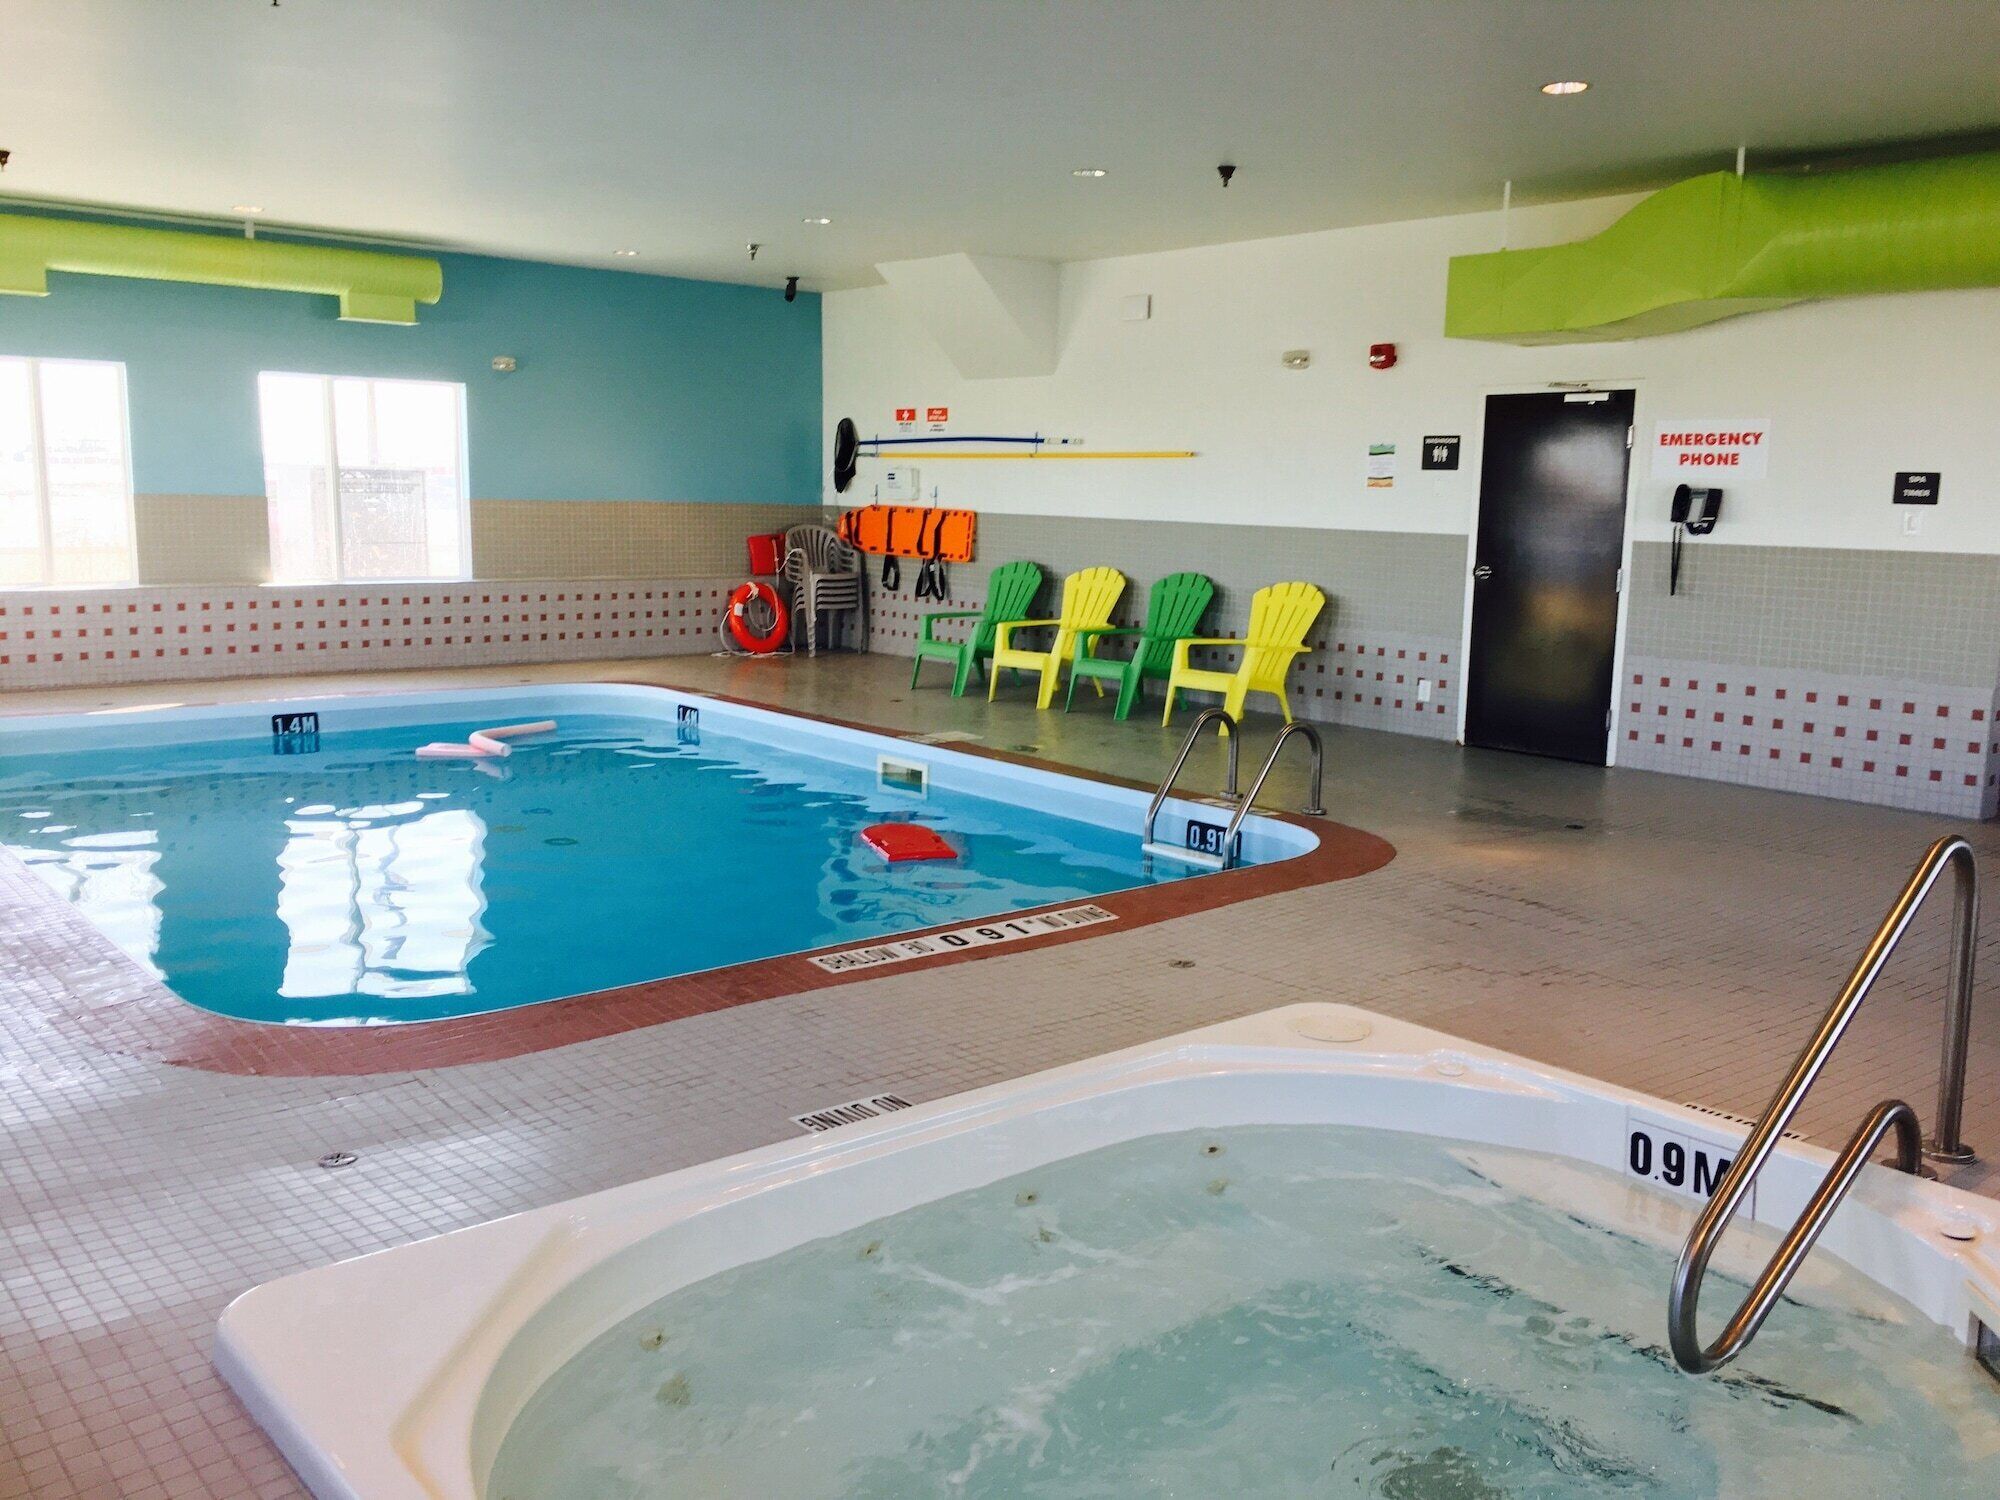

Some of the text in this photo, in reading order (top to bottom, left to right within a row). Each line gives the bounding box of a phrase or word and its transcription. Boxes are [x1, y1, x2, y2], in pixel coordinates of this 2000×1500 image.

[1660, 431, 1763, 446] EMERGENCY
[1679, 453, 1740, 466] PHONE
[274, 715, 316, 736] 1.4M
[1189, 825, 1240, 858] 0.91
[798, 1095, 913, 1132] NO DIVING
[1630, 1131, 1732, 1198] 0.9M
